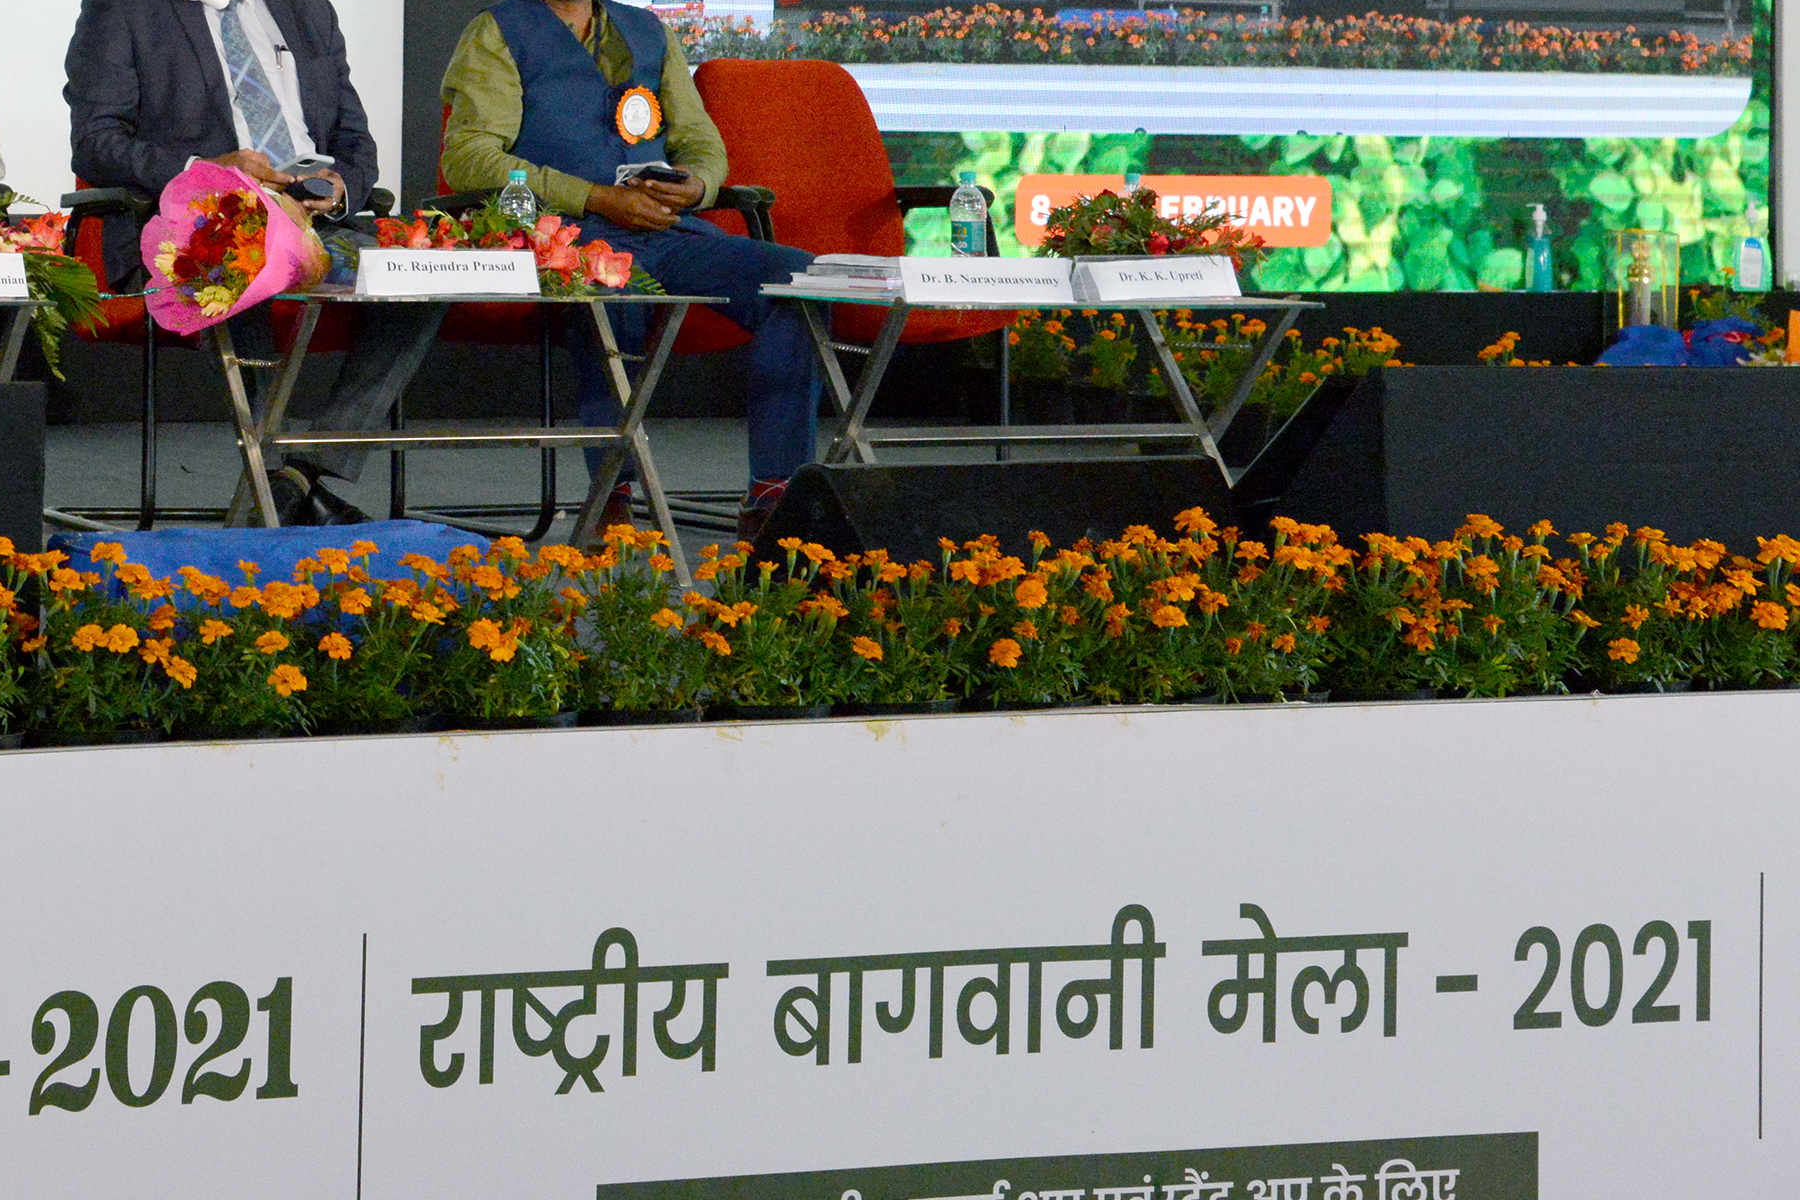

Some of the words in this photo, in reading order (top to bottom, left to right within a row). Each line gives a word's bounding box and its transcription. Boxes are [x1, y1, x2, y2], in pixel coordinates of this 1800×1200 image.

[387, 262, 407, 271] Dr.
[411, 261, 469, 274] Rajendra
[473, 261, 515, 271] Prasad
[921, 274, 940, 283] Dr.
[944, 274, 957, 283] B.
[960, 274, 1059, 287] Narayanaswamy
[1118, 272, 1138, 282] Dr.
[1138, 271, 1153, 281] K.
[1154, 271, 1168, 281] K.
[1169, 270, 1204, 283] Upreti
[411, 927, 729, 1095] राष्ट्रीय
[766, 904, 1166, 1066] बागवानी
[1202, 903, 1408, 1043] मेला
[1513, 920, 1711, 1030] 2021
